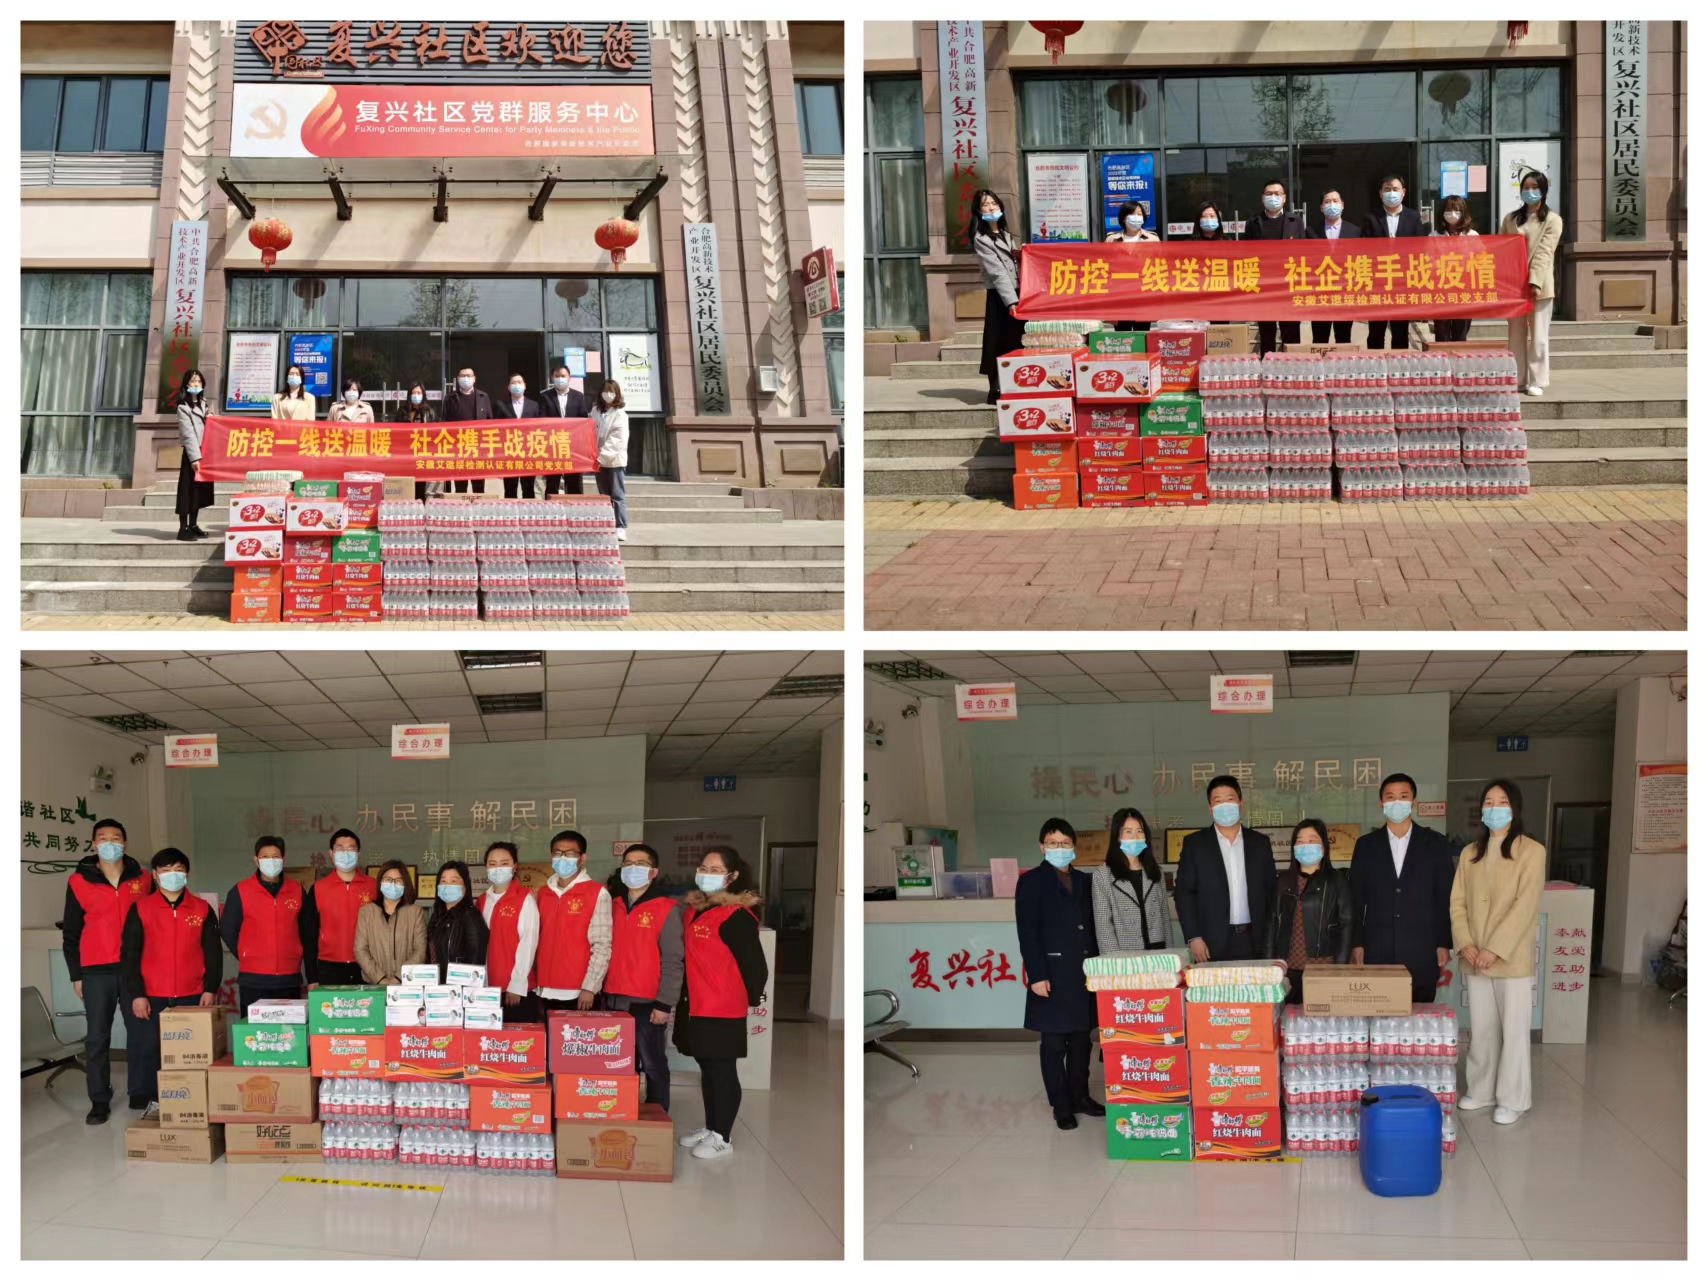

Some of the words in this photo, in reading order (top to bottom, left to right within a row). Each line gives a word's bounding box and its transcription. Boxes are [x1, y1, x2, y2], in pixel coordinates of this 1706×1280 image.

[328, 20, 639, 72] 复兴社区欢迎您
[356, 100, 640, 123] 复兴社区党群服务中心
[354, 125, 385, 134] FuXing
[388, 125, 436, 134] Community
[439, 125, 471, 133] Service
[474, 125, 502, 133] Center
[1611, 60, 1641, 236] 复兴社区居民委员会
[689, 227, 701, 273] 产业开发区
[701, 227, 713, 273] 合肥高新技术
[1050, 257, 1261, 295] 防控一线送温暖
[1284, 252, 1496, 292] 社企携手战疫情
[693, 276, 725, 412] 复兴社区居民委员会
[1020, 367, 1040, 380] 3+2
[1098, 372, 1118, 384] 3+2
[1018, 408, 1040, 420] 3+2
[227, 428, 392, 457] 防控一线送温暖
[410, 428, 571, 458] 社企携手战疫情
[1217, 690, 1266, 701] 综合办理
[963, 698, 1009, 710] 综合办理
[398, 738, 443, 748] 综合办理
[171, 748, 212, 758] 综合办理
[1153, 760, 1257, 796] 办民事
[1273, 757, 1382, 791] 解民困
[355, 800, 454, 833] 办民事
[471, 799, 577, 831] 解民困
[423, 850, 480, 867] 热情周
[1554, 928, 1587, 938] 奉献
[909, 948, 1029, 993] 复兴社
[1552, 964, 1585, 974] 互助
[1349, 983, 1371, 991] LUX
[1551, 982, 1585, 992] 进步
[1115, 1012, 1164, 1024] 红烧牛肉面
[401, 1049, 446, 1059] 红烧牛肉面
[480, 1052, 528, 1063] 红烧牛肉面
[1121, 1071, 1170, 1081] 红烧牛肉面
[1212, 1127, 1262, 1138] 红烧牛肉面
